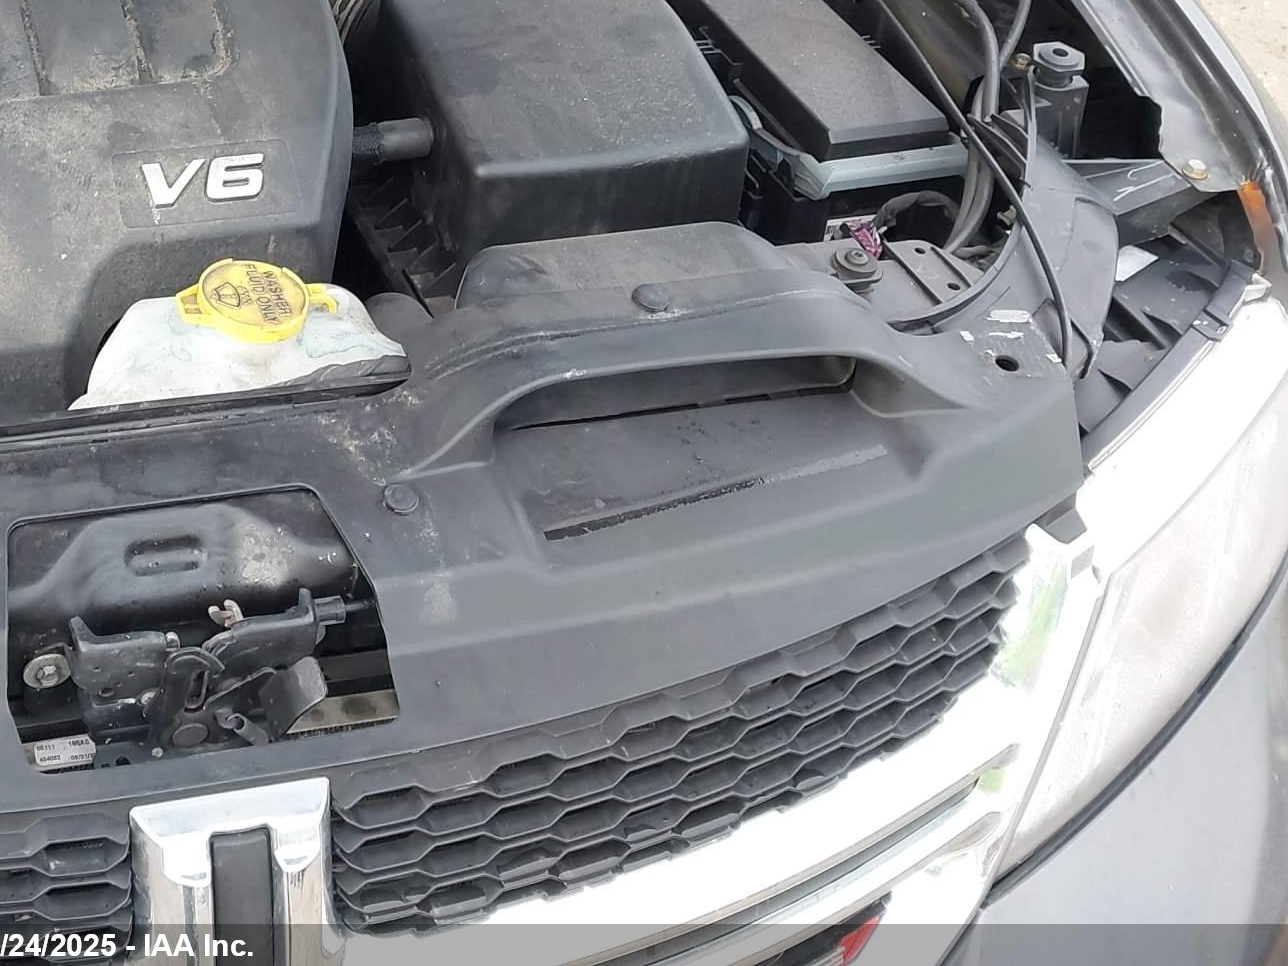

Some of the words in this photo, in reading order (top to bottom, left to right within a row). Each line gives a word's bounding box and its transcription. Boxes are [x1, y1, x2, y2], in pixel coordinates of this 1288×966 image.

[141, 153, 264, 209] V6
[244, 263, 265, 294] FLUID
[255, 295, 281, 325] ONLY
[262, 270, 294, 317] WASHER
